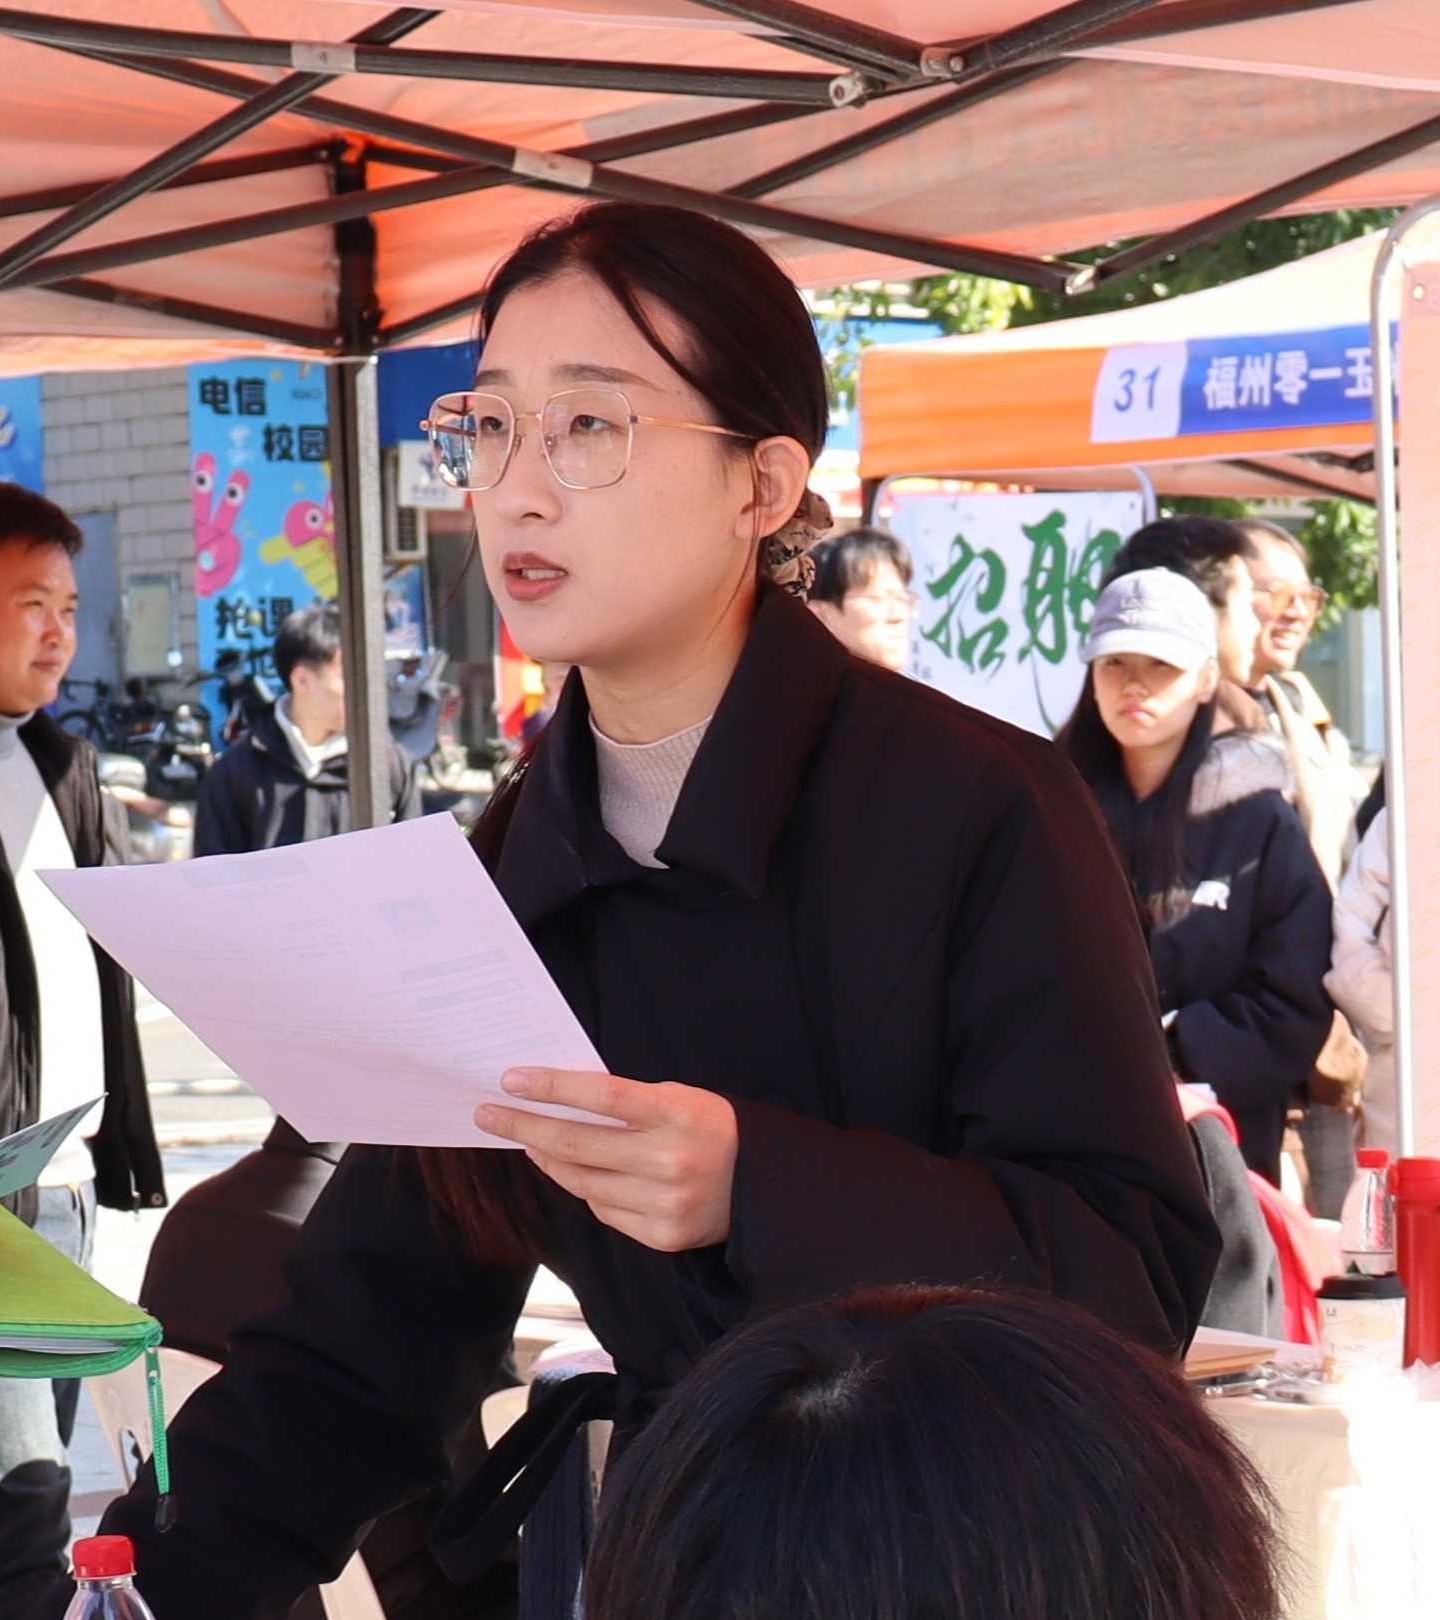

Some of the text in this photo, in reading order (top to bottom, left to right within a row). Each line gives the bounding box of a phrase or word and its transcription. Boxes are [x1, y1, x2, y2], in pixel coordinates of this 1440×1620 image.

[199, 376, 267, 416] 电信
[1113, 366, 1161, 412] 31
[262, 423, 328, 462] 校园
